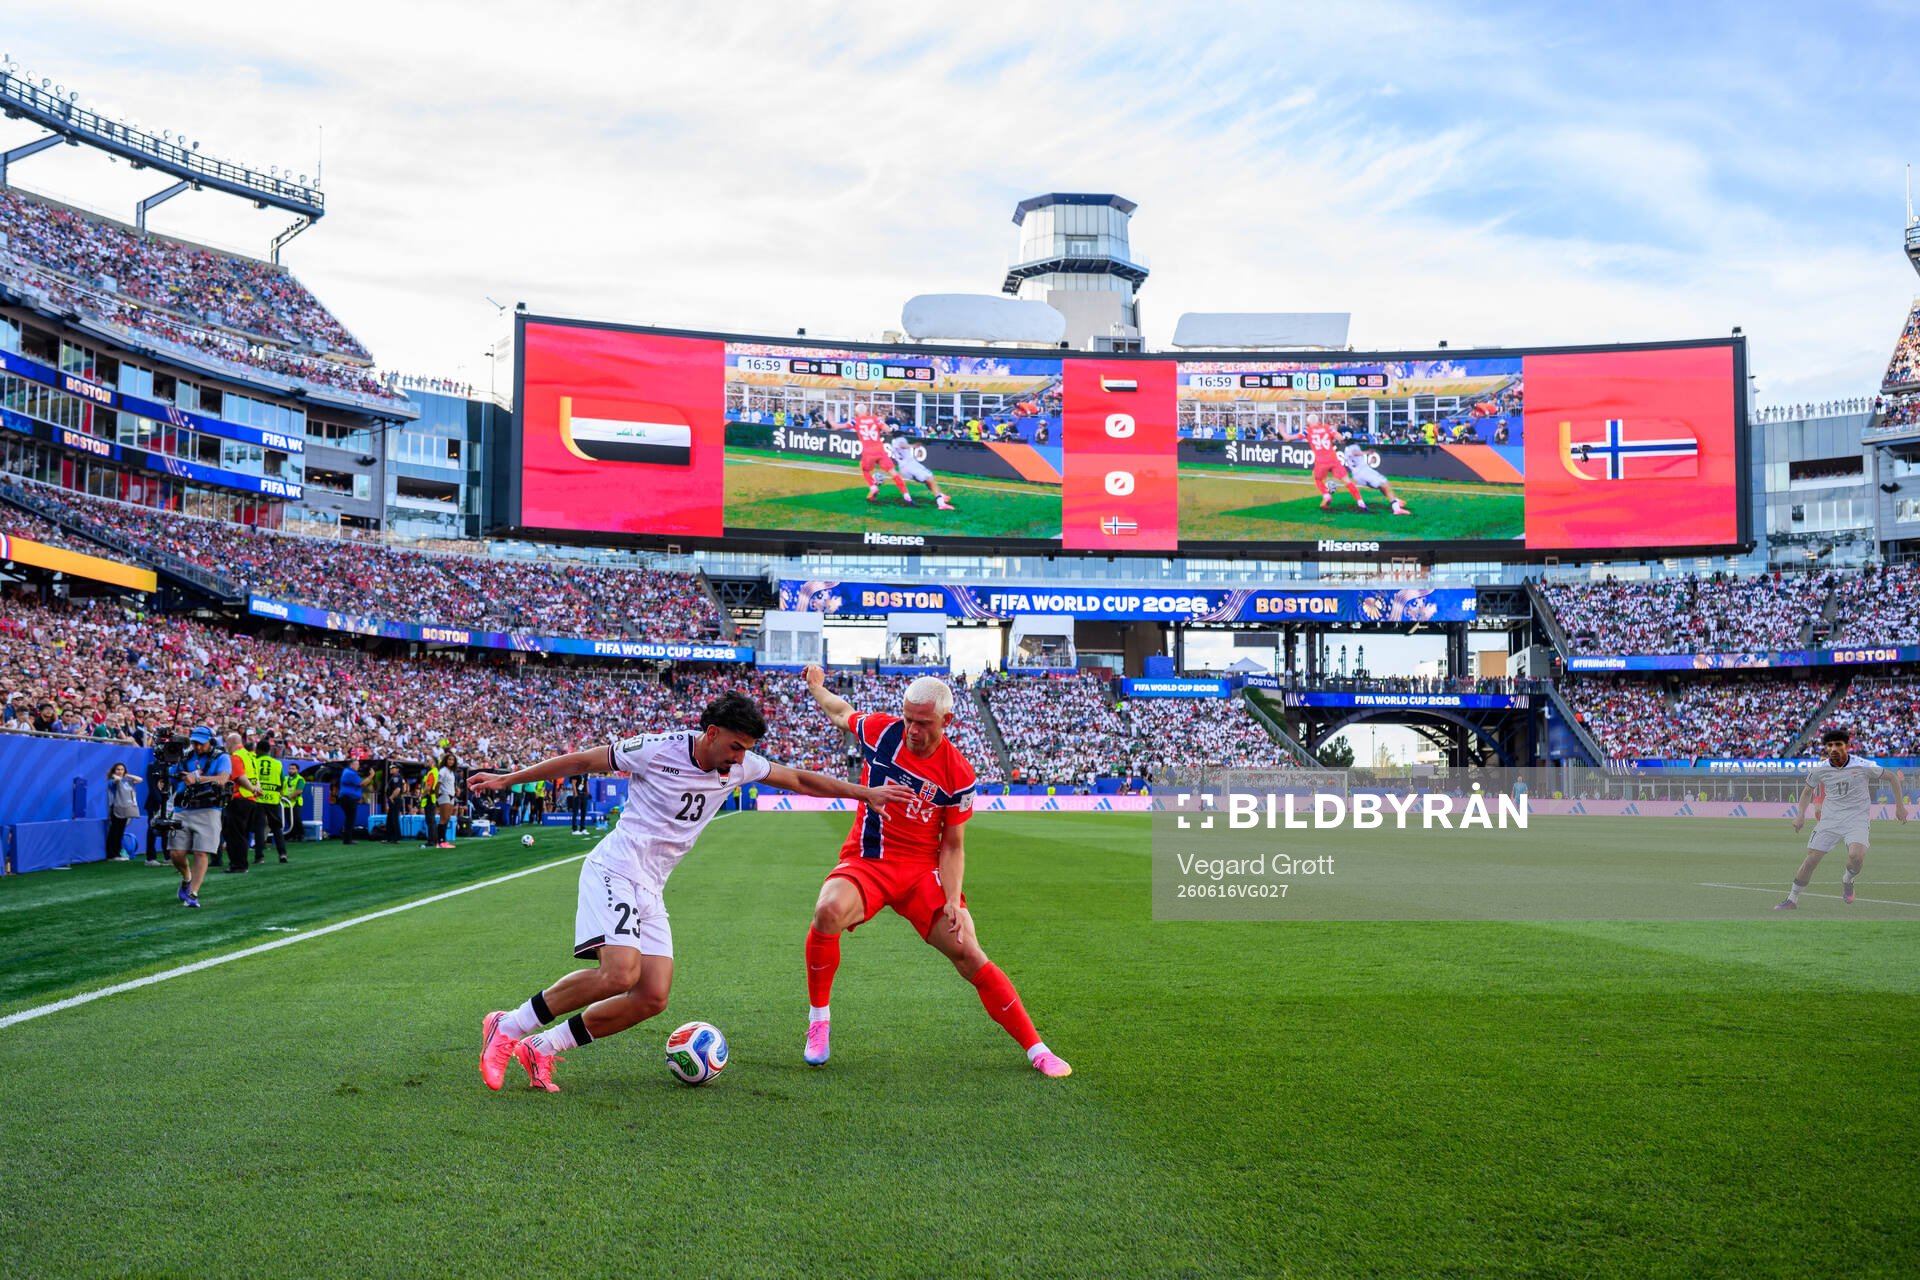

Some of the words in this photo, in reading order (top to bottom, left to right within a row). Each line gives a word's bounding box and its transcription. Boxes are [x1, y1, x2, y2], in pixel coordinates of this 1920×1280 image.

[746, 359, 781, 372] 16:59
[846, 366, 852, 375] 0
[873, 368, 879, 376] 0
[66, 376, 112, 404] BOSTON
[1198, 376, 1232, 388] 16:59
[1297, 377, 1303, 387] 0
[1324, 377, 1330, 386] 0
[1338, 376, 1357, 387] NOR
[64, 430, 110, 456] BOSTON
[262, 432, 287, 449] FIFA
[789, 434, 826, 451] Inter
[1241, 444, 1278, 462] Inter
[260, 479, 286, 496] FIFA
[864, 532, 924, 546] Hisense
[1318, 540, 1380, 552] Hisense
[862, 592, 943, 609] BOSTON
[990, 594, 1030, 611] FIFA
[1032, 595, 1101, 612] WORLD
[1103, 596, 1140, 612] CUP
[1142, 596, 1208, 613] 2026
[1256, 597, 1338, 614] BOSTON
[422, 627, 469, 644] BOSTON
[594, 642, 621, 654] FIFA
[622, 644, 666, 657] WORLD
[667, 647, 691, 658] CUP
[1834, 649, 1897, 662] BOSTON
[1248, 677, 1278, 688] BOSTON
[1355, 696, 1374, 704] FIFA
[1375, 696, 1408, 705] WORLD
[1409, 696, 1428, 705] CUP
[1428, 696, 1460, 705] 2026
[662, 766, 680, 775] JAKO
[1710, 761, 1741, 773] FIFA
[1744, 761, 1795, 773] WORLD
[1836, 782, 1848, 795] 17
[675, 792, 706, 821] 23
